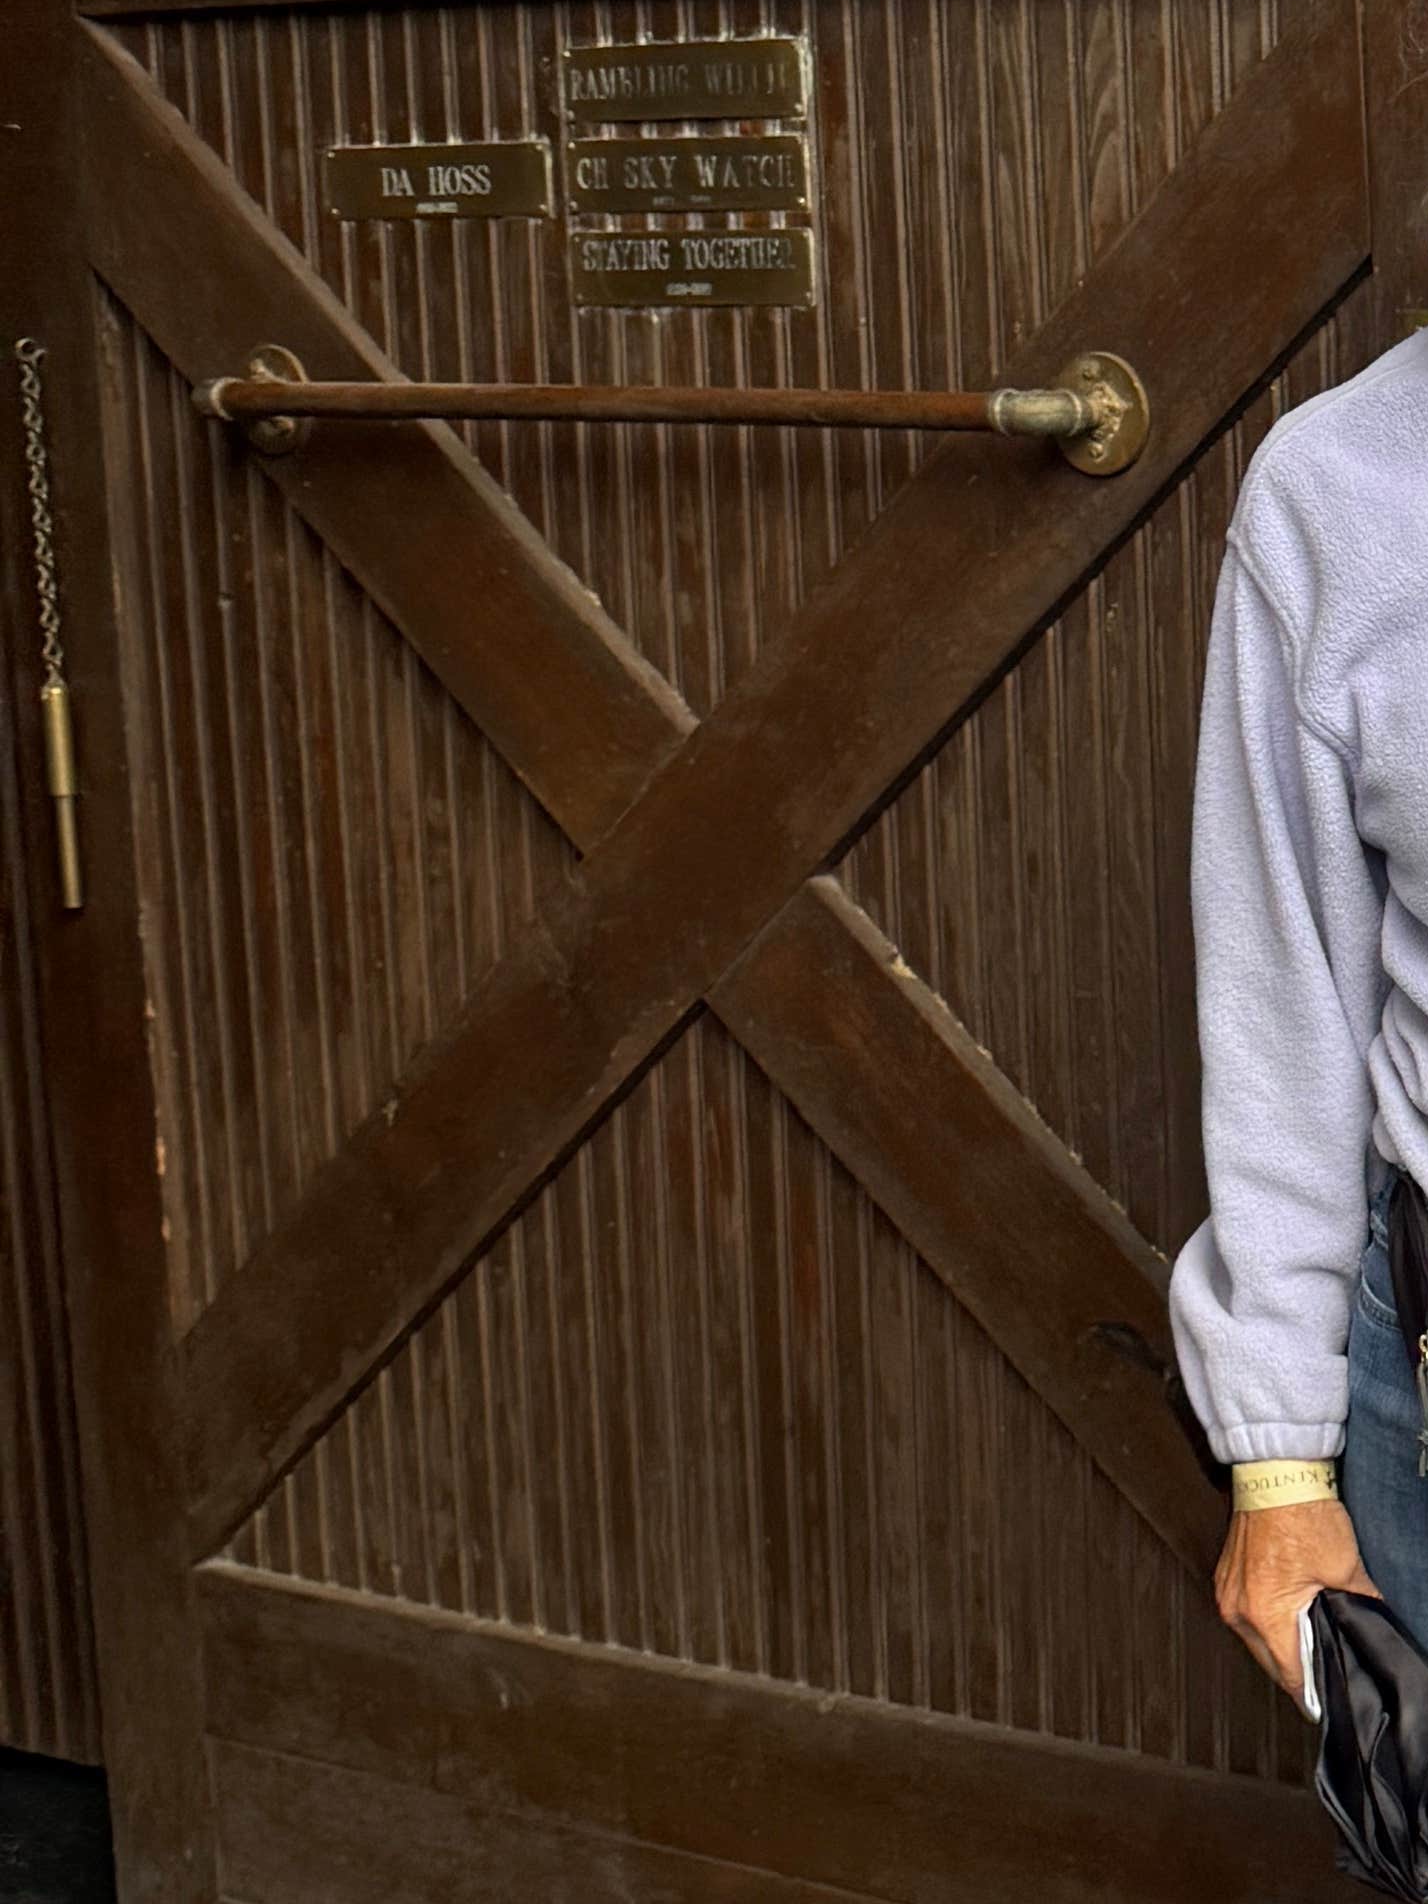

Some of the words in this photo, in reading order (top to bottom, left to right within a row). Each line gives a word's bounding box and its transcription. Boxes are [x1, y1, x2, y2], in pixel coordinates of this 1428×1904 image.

[381, 166, 416, 197] DA
[428, 164, 493, 197] HOSS
[576, 157, 609, 191] CH
[624, 155, 678, 190] SKY
[582, 238, 671, 272] STAYING
